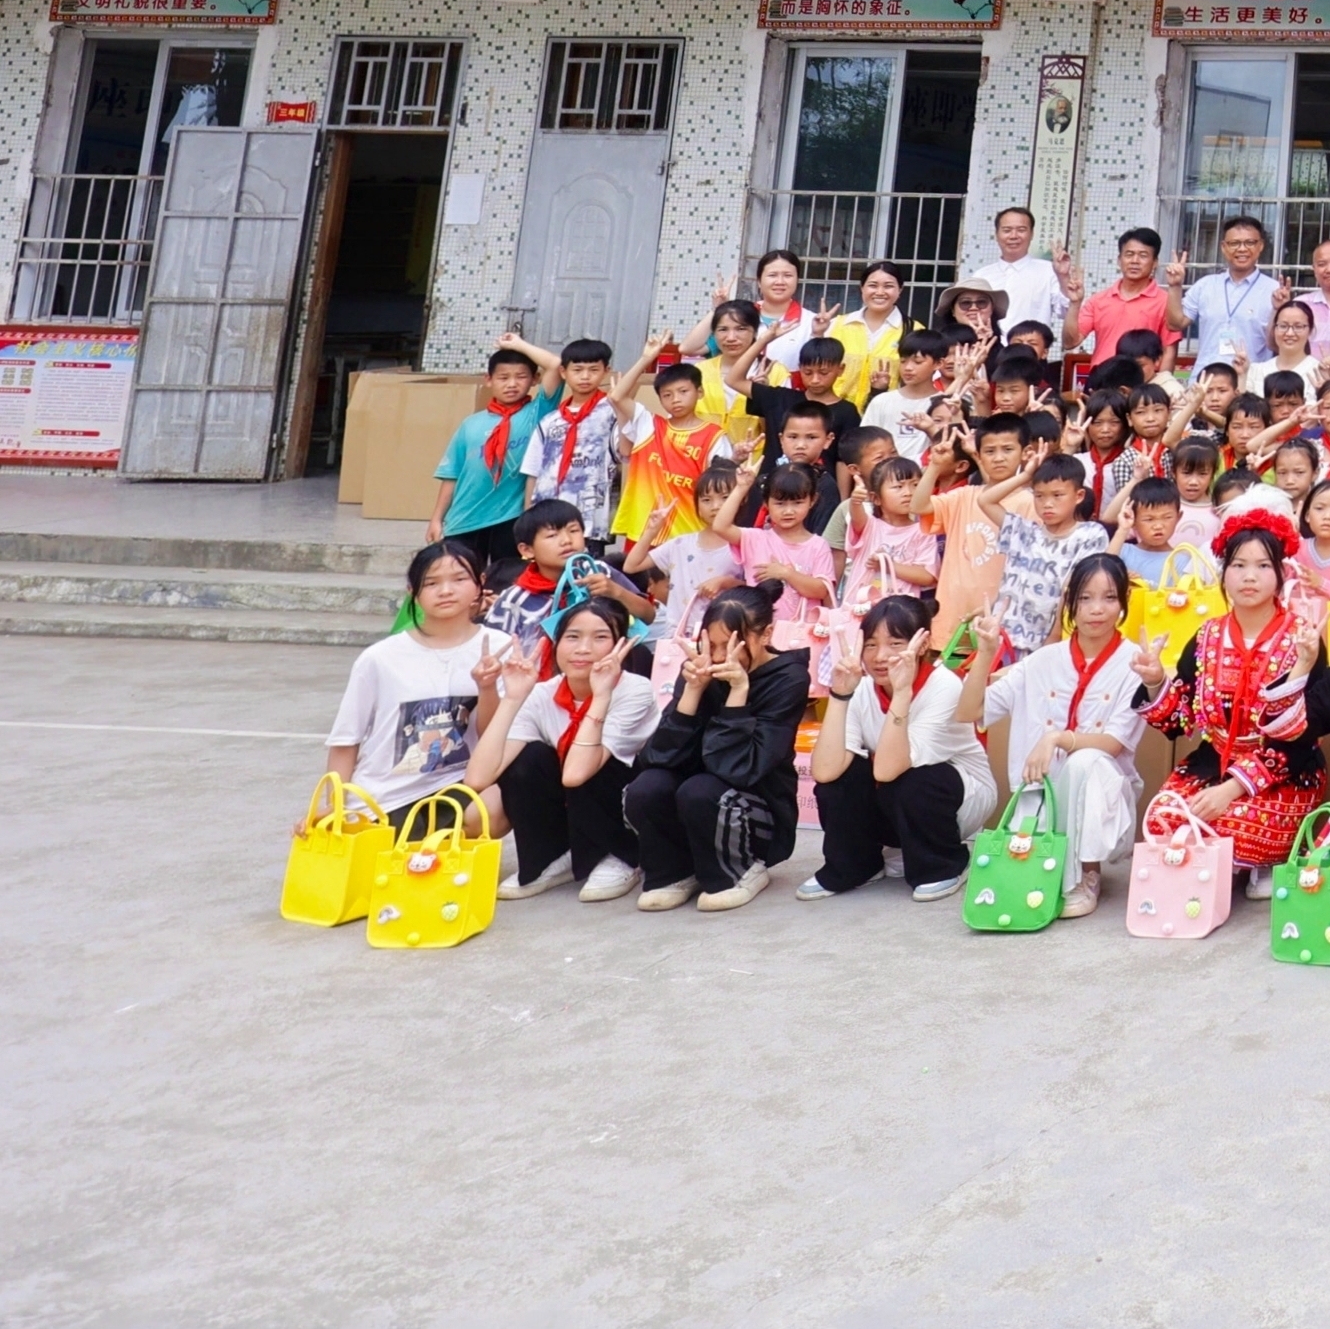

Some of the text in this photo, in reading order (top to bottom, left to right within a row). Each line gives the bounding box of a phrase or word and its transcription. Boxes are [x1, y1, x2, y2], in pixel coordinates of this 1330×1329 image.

[1184, 6, 1324, 25] 生活更美好。
[278, 107, 306, 119] 三年级
[684, 444, 702, 461] 30
